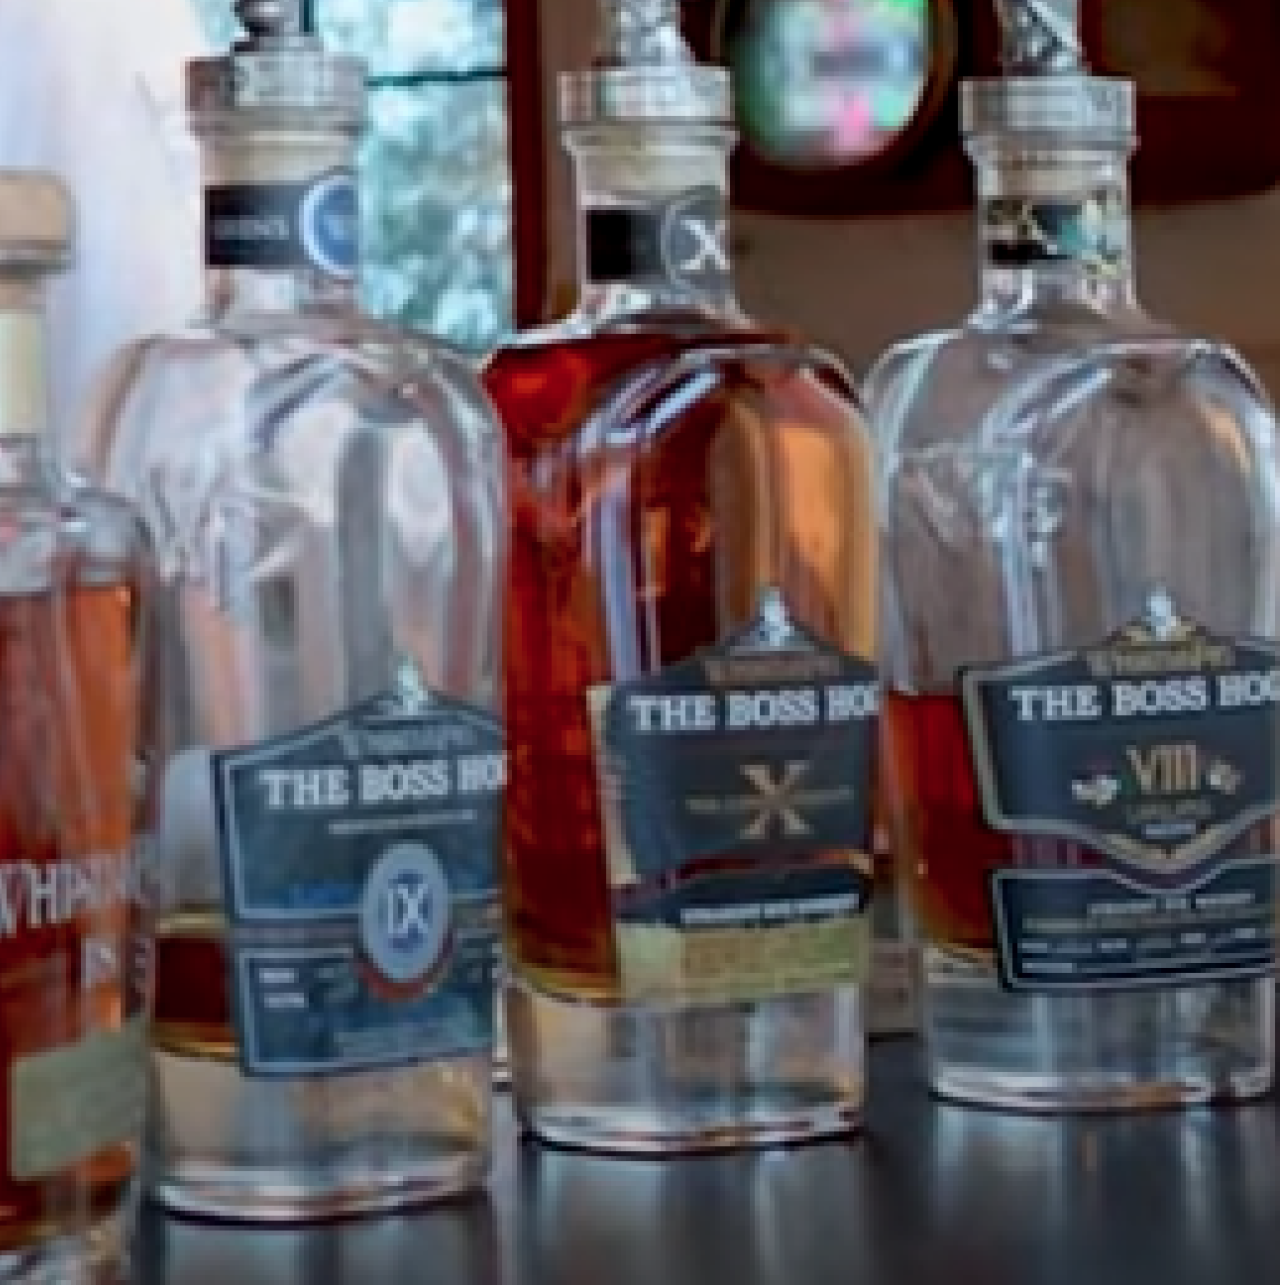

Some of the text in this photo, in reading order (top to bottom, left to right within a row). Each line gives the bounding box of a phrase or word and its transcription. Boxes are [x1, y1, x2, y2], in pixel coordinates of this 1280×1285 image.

[680, 219, 731, 270] X
[627, 694, 717, 732] THE
[725, 690, 816, 730] BOSS
[1013, 685, 1102, 720] THE
[1111, 677, 1207, 715] BOSS
[256, 768, 349, 808] THE
[358, 760, 449, 805] BOSS
[737, 760, 813, 840] X
[387, 883, 430, 937] IX
